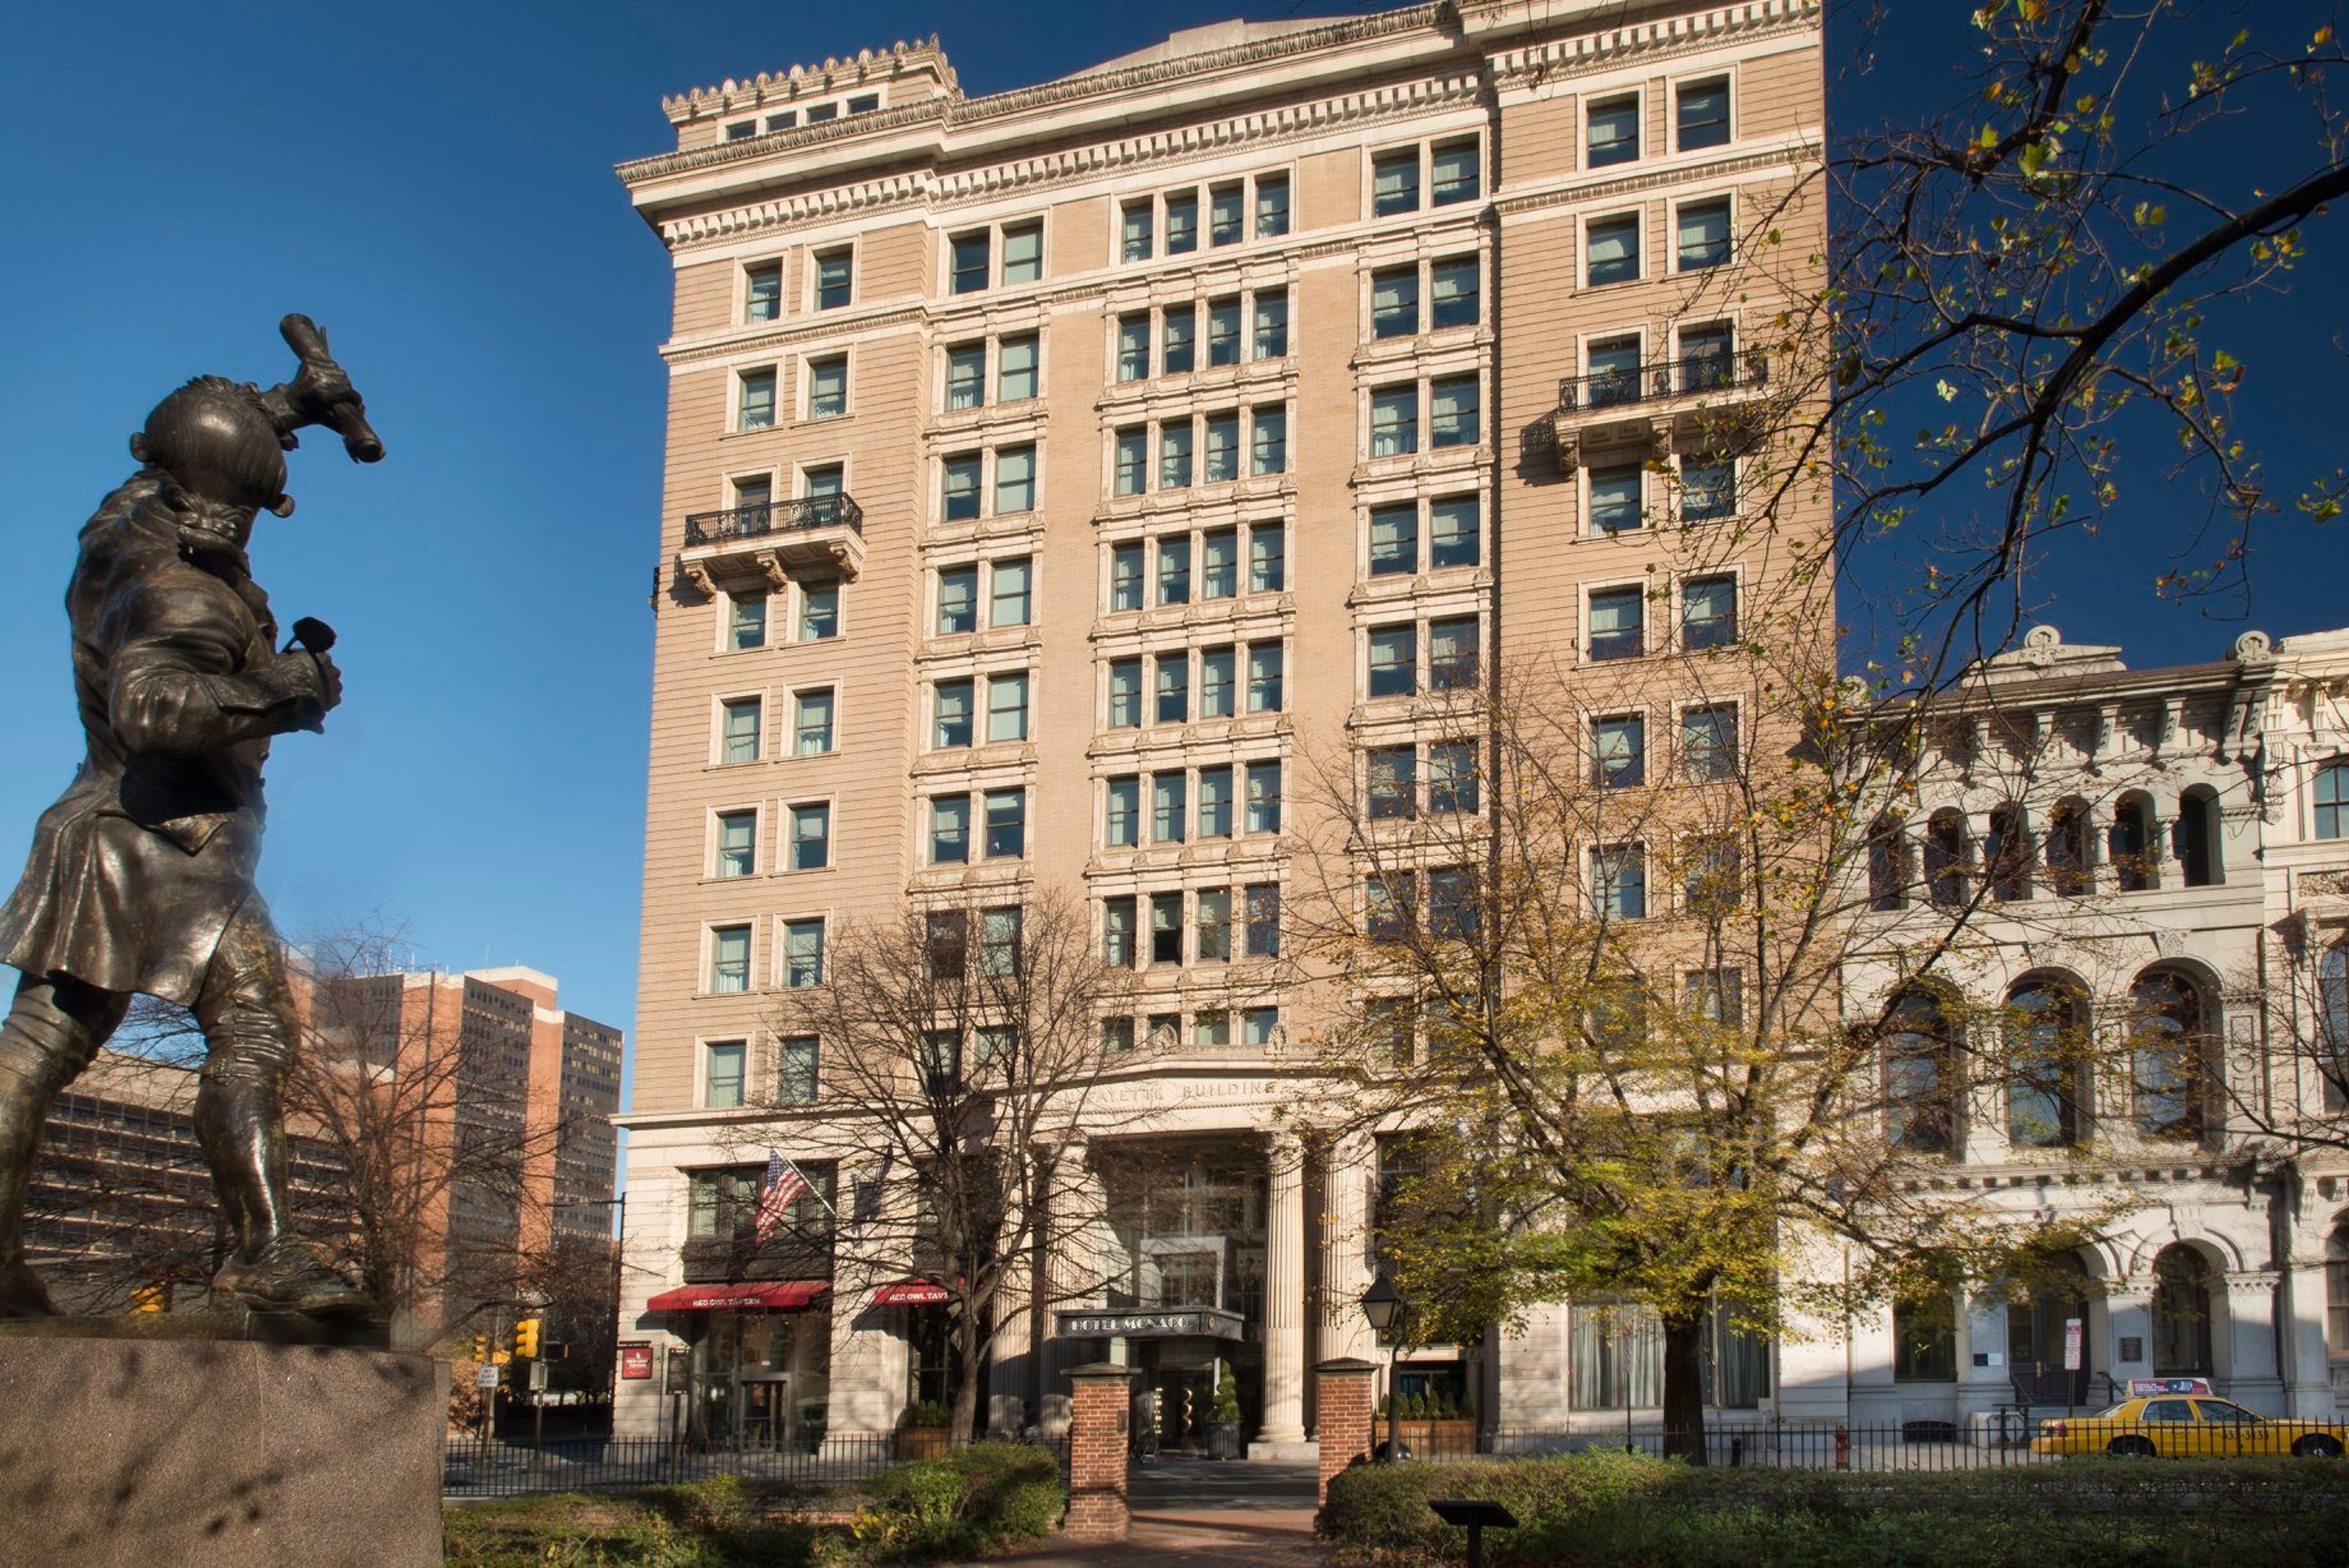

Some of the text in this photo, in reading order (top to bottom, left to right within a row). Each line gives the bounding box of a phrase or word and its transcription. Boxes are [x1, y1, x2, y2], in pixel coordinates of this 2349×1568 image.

[1182, 1082, 1275, 1098] BUILDIN
[1071, 1317, 1189, 1331] HOTEL MONACO
